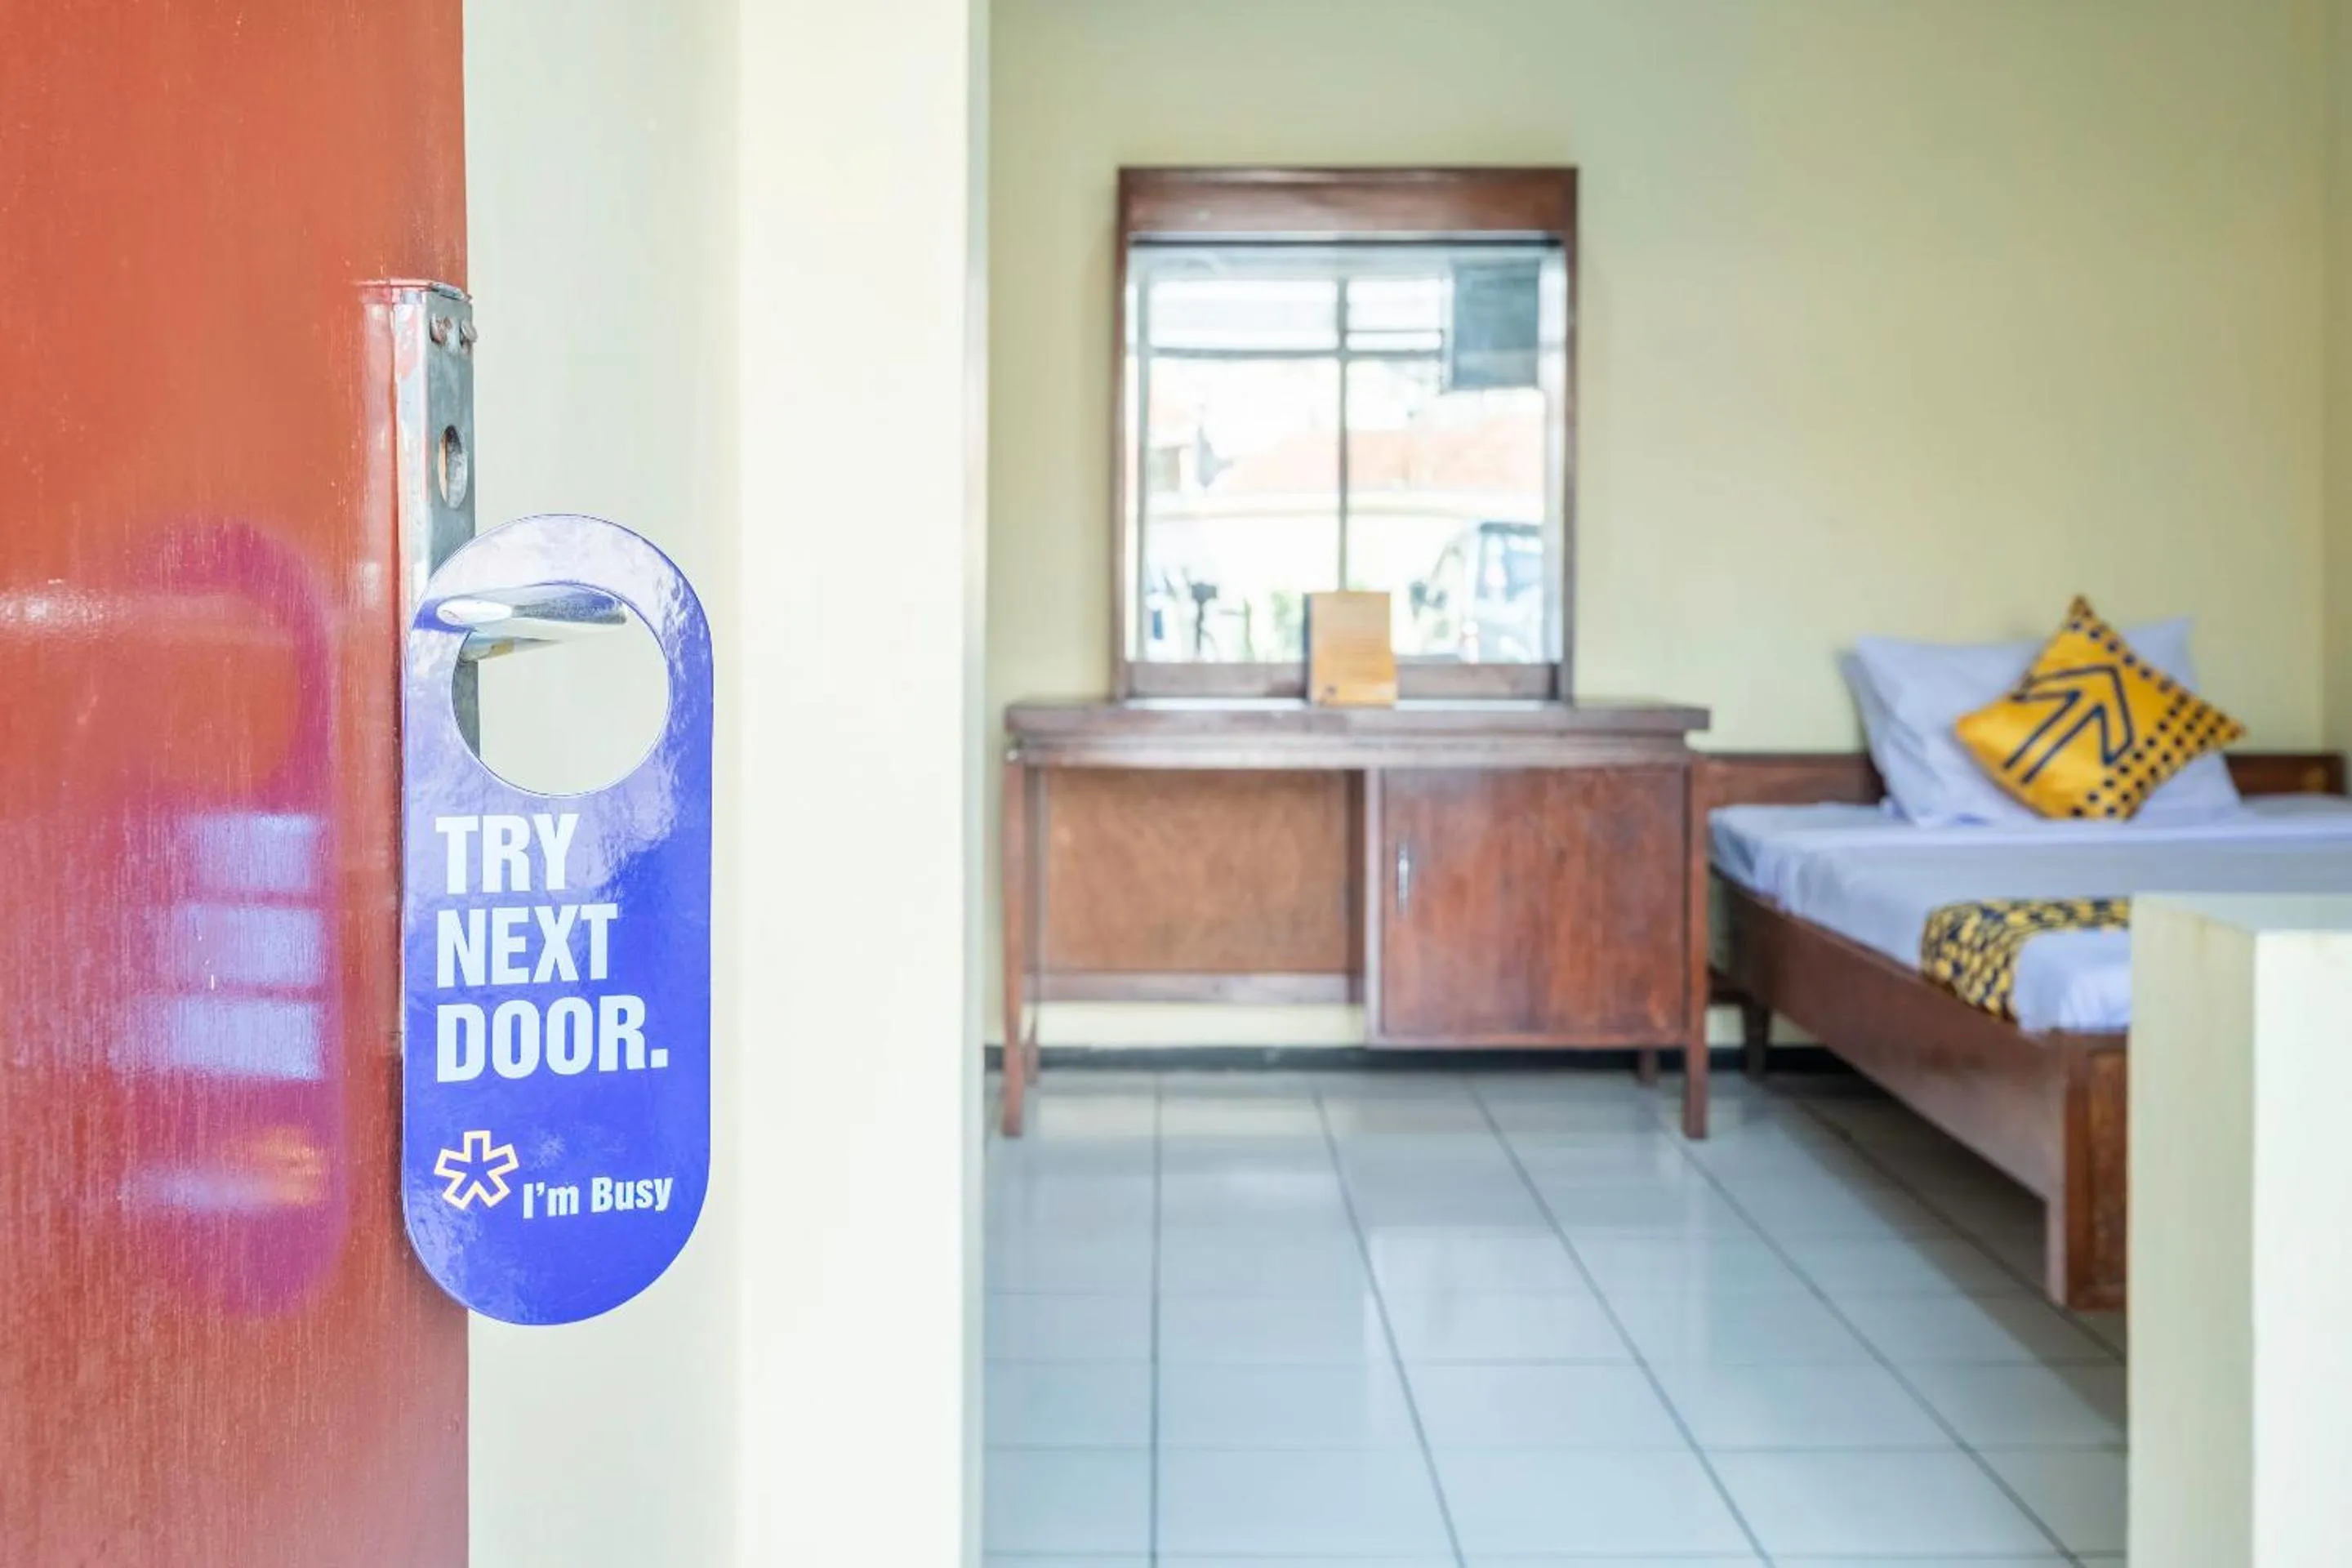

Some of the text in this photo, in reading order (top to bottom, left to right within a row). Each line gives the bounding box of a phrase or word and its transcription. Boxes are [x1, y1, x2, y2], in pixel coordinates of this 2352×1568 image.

[435, 813, 579, 894] TRY
[436, 903, 617, 988] NEXT
[436, 995, 668, 1083] DOOR.
[523, 1177, 673, 1218] I’m Busy
